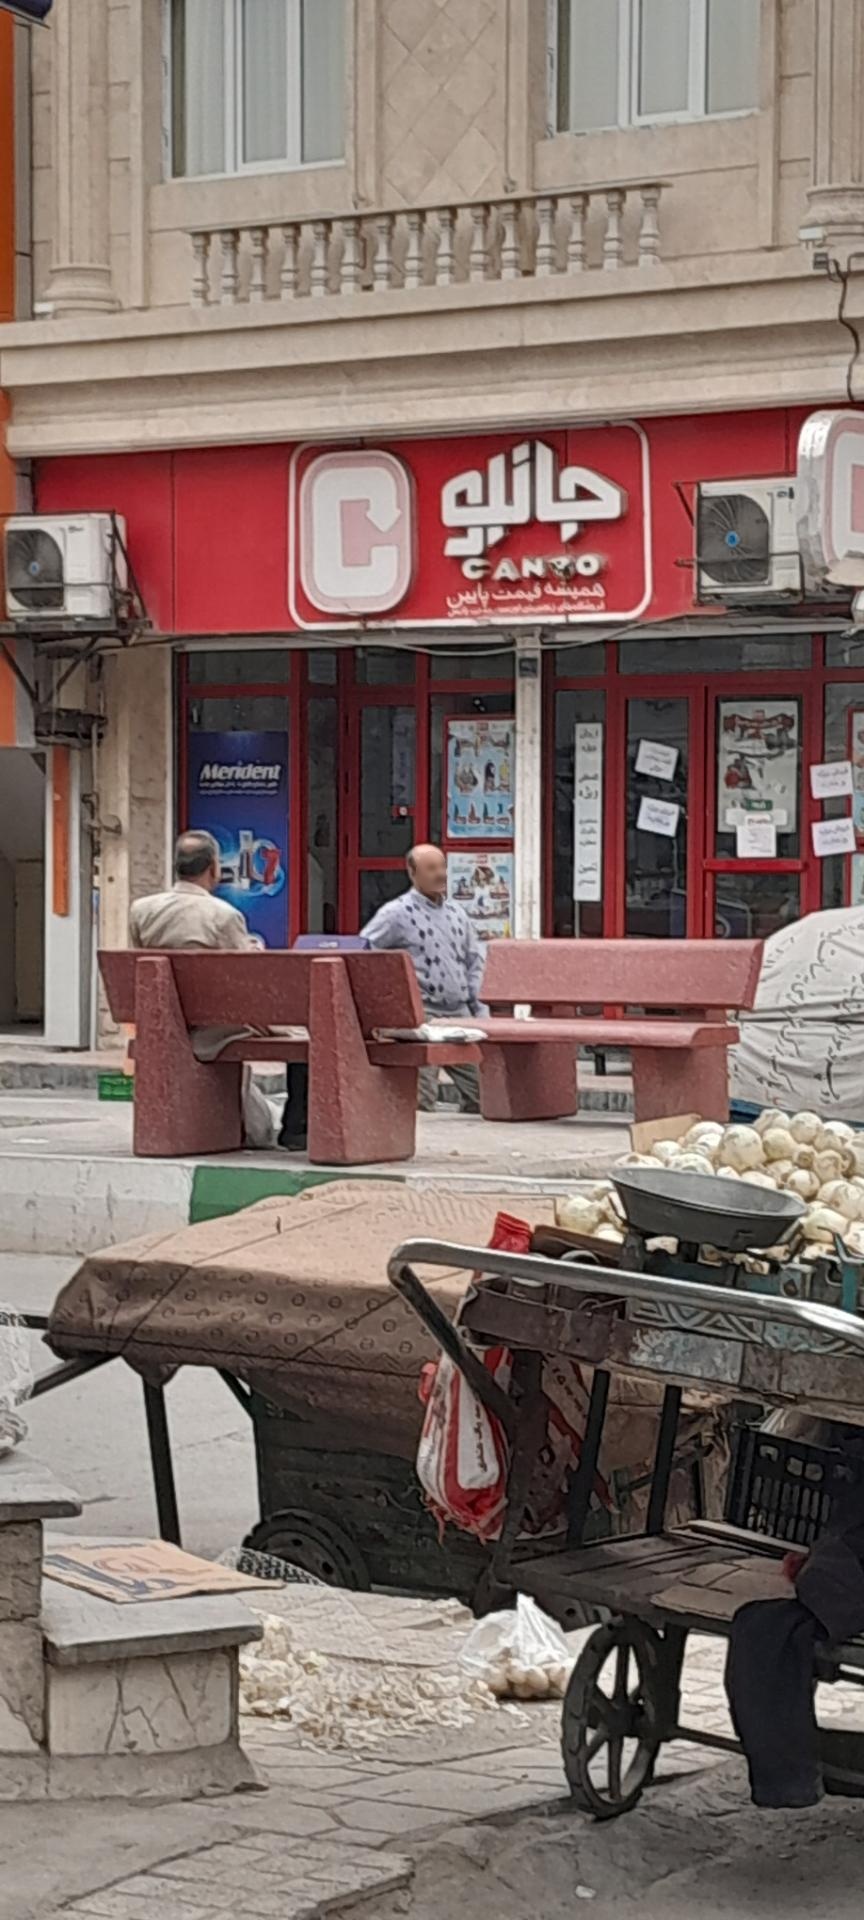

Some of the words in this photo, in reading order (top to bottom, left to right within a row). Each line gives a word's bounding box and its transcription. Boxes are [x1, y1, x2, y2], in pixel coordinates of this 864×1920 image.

[446, 582, 490, 608] پایین
[491, 582, 541, 602] قیمت
[543, 581, 606, 599] همیشه
[200, 761, 281, 780] Merident
